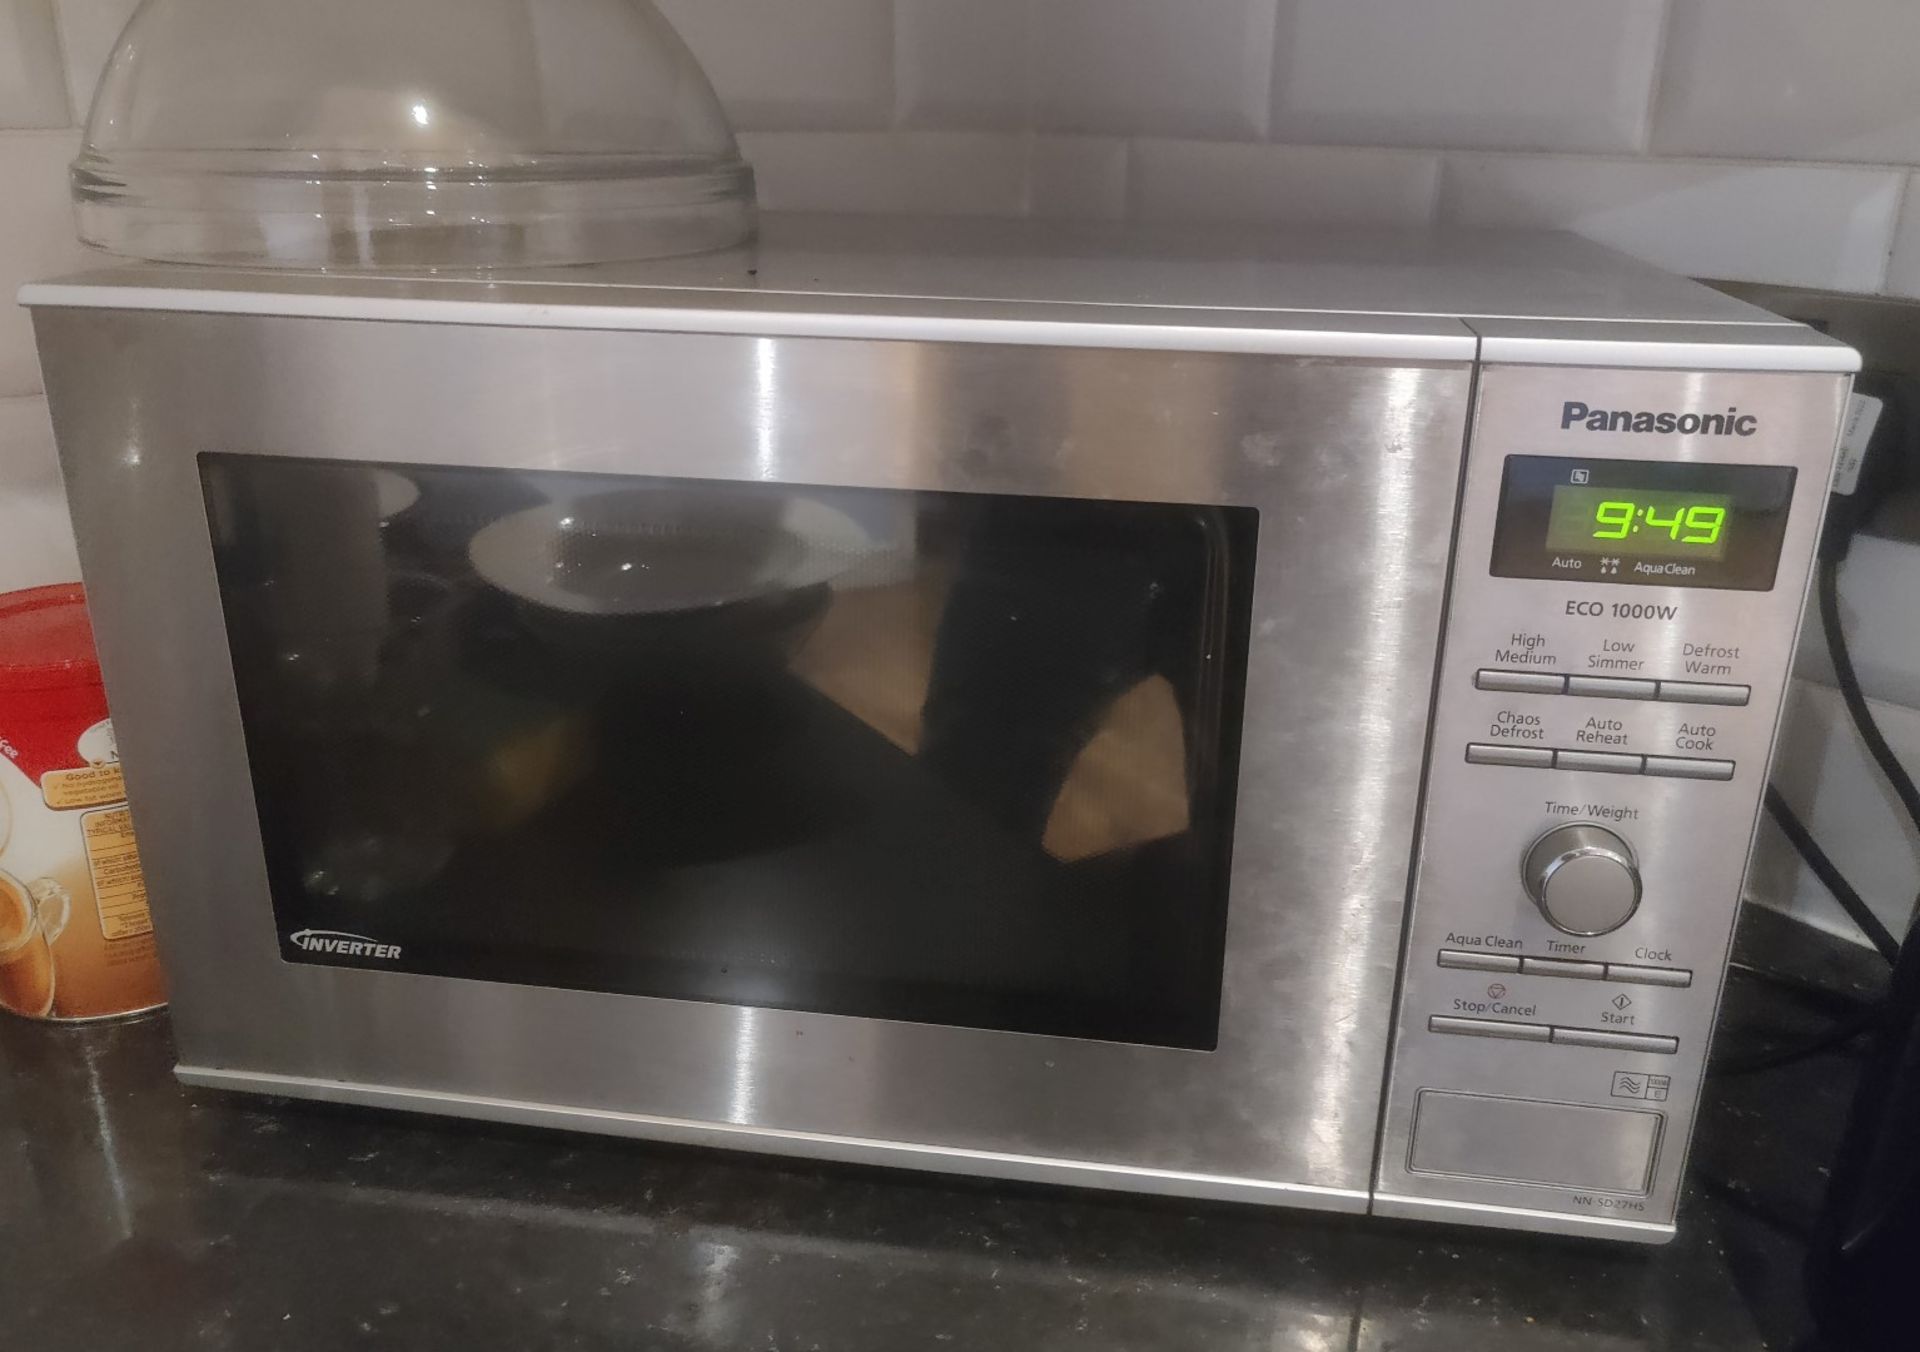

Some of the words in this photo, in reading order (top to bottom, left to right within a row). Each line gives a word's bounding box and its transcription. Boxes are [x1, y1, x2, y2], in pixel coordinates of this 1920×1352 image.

[1560, 401, 1758, 437] Panasonic
[1592, 501, 1727, 544] 9:49
[1551, 556, 1582, 569] Auto
[1565, 600, 1604, 617] ECO
[1612, 603, 1678, 620] 1000W
[1511, 633, 1546, 649] High
[1602, 639, 1636, 653] Low
[1495, 649, 1557, 665] Medium
[1682, 643, 1740, 659] Defrost
[1587, 654, 1645, 671] Simmer
[1684, 660, 1732, 676] Warm
[1496, 710, 1541, 726] Chaos
[1585, 717, 1623, 731] Auto
[1490, 724, 1544, 740] Defrost
[1677, 722, 1717, 737] Auto
[1576, 730, 1628, 746] Reheat
[1675, 737, 1714, 751] Cook
[66, 771, 96, 781] Good
[100, 769, 110, 777] to
[1545, 801, 1639, 820] Time/Weight
[300, 935, 403, 960] INVERTER
[1445, 932, 1482, 949] Aqua
[1485, 936, 1524, 950] Clean
[1546, 940, 1587, 955] Timer
[1634, 947, 1672, 962] Clock
[1453, 998, 1537, 1017] Stop/Cancel
[1600, 1011, 1635, 1026] Start
